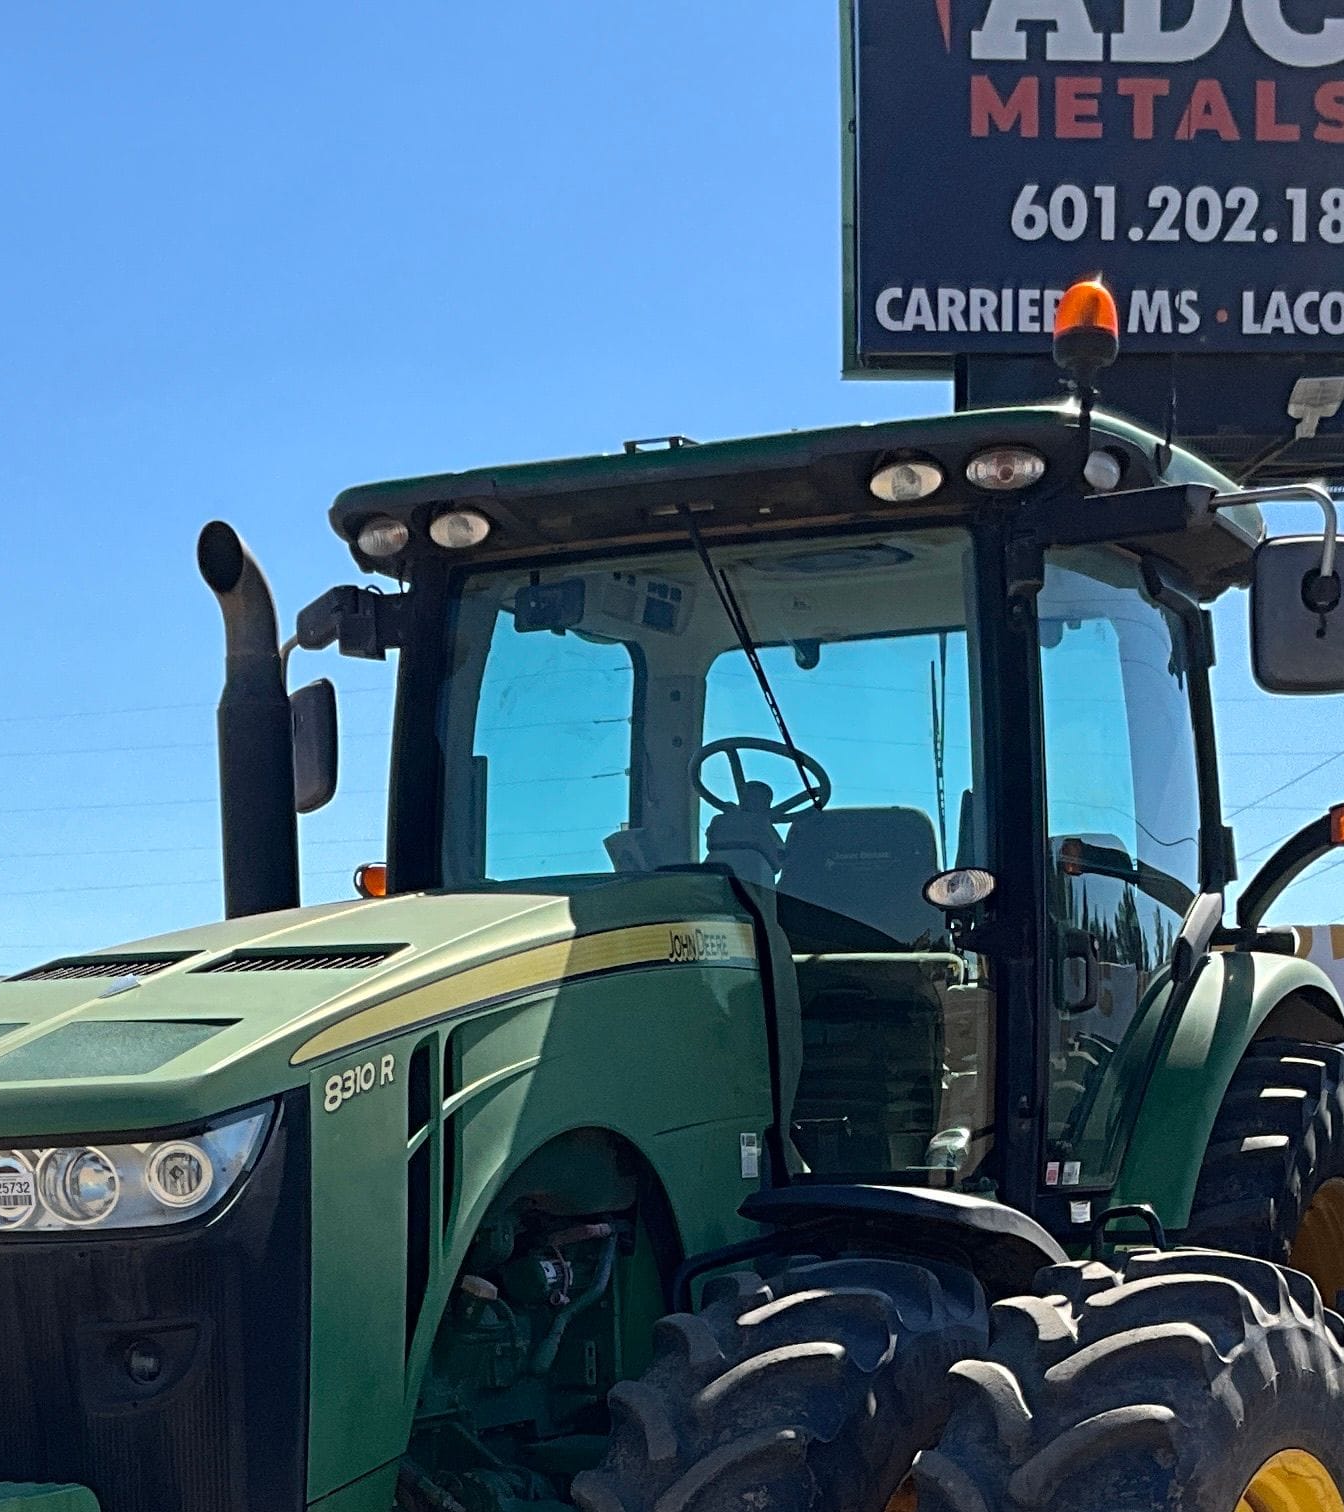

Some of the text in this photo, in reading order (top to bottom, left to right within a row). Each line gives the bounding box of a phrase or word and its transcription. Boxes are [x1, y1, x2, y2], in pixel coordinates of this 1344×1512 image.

[1126, 288, 1201, 335] MS
[668, 928, 730, 962] JOHN DEERE
[324, 1054, 395, 1112] 8310 R
